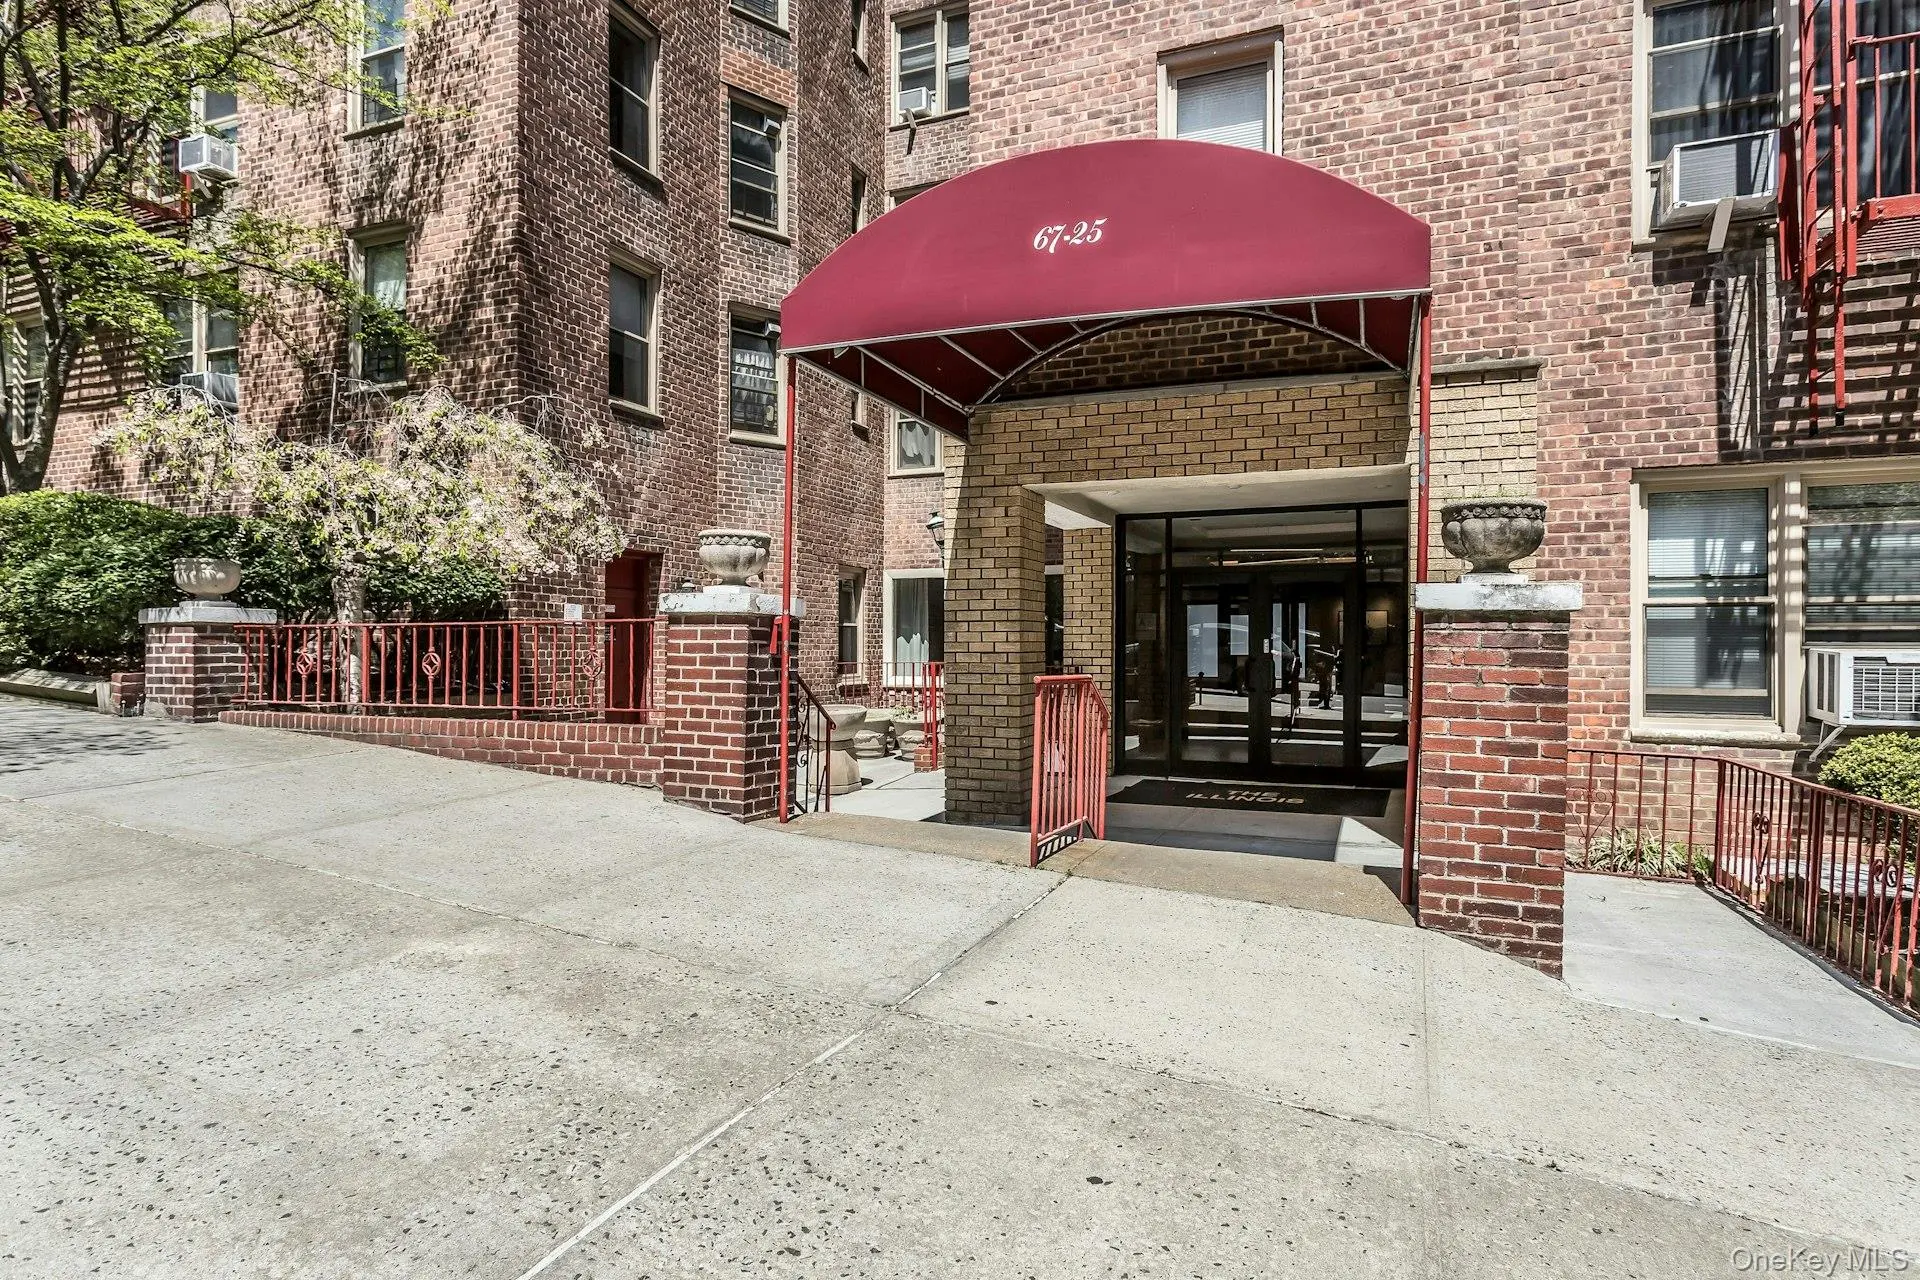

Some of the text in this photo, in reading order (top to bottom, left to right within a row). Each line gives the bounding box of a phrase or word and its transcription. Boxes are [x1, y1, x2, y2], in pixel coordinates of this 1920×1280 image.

[1033, 217, 1108, 254] 67-25
[1185, 793, 1305, 804] ILLINOIS
[1228, 790, 1280, 798] THE
